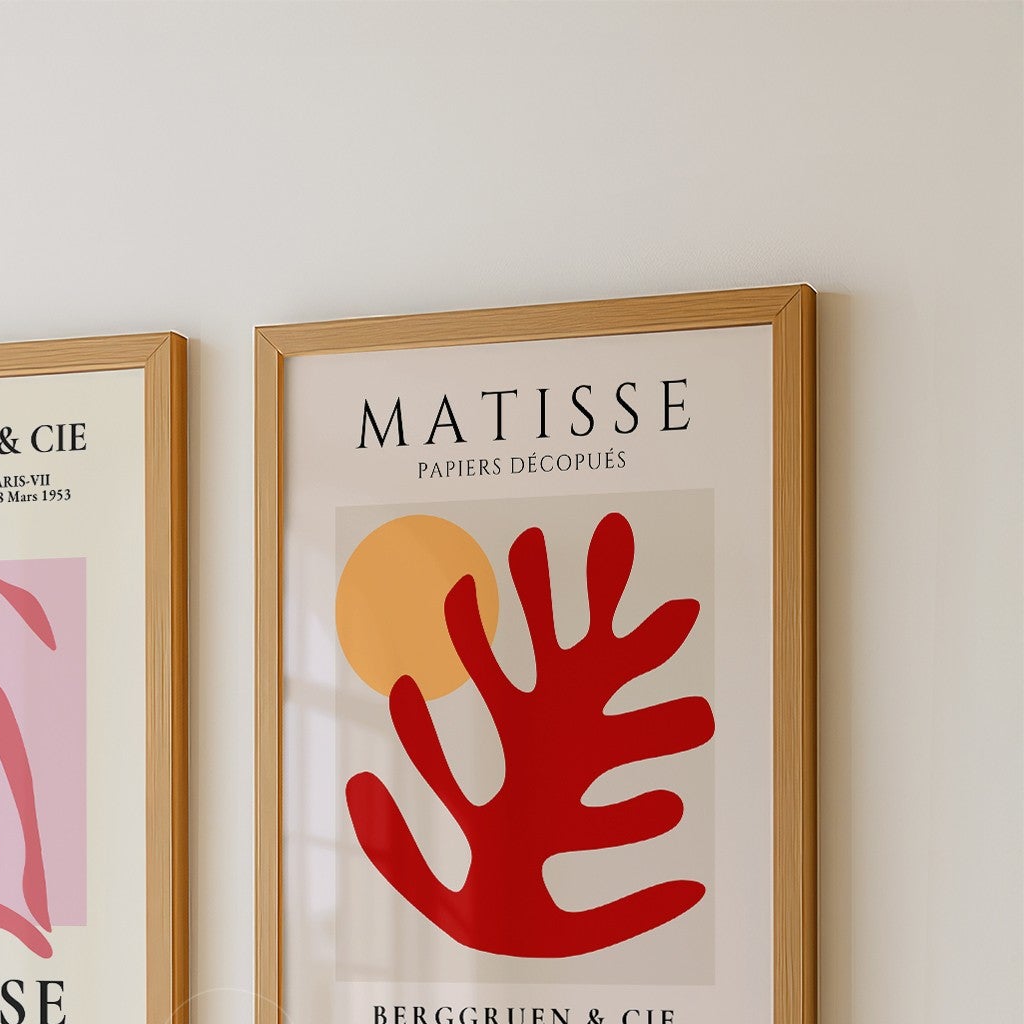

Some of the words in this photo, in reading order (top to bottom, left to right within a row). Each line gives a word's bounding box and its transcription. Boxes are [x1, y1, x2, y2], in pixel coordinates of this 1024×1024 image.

[355, 377, 692, 450] MATISSE
[30, 422, 88, 454] CIE
[418, 457, 502, 480] PAPIERS
[510, 447, 627, 475] DÉCOPUÉS
[7, 491, 38, 503] Mars
[42, 488, 72, 502] 1953
